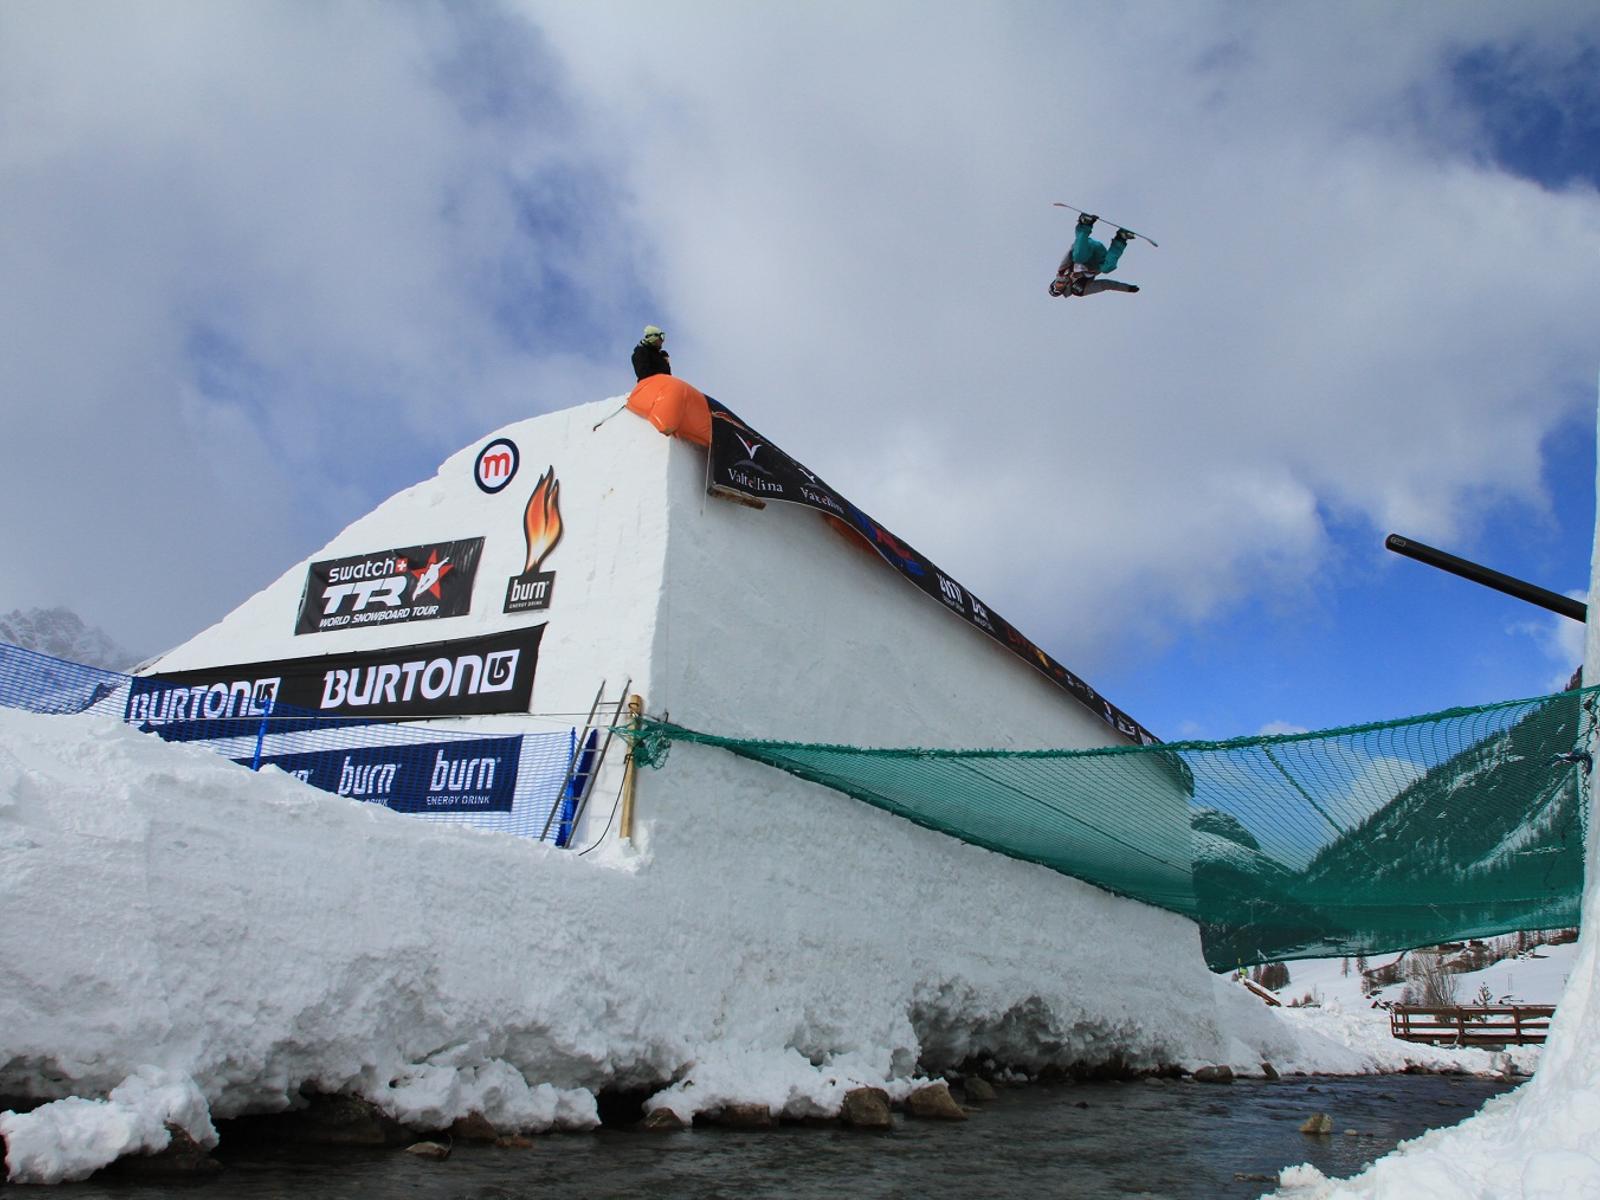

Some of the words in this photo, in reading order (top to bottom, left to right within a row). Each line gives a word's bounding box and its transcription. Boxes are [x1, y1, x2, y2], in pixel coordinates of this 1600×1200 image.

[728, 468, 783, 493] Valtellina
[322, 576, 407, 615] TTR
[511, 579, 546, 602] burn
[320, 616, 350, 628] WORLD
[351, 608, 409, 623] SNOWBOARD
[412, 605, 439, 617] TOUR
[320, 655, 483, 709] BURTON
[129, 680, 253, 726] BURTON
[337, 756, 396, 796] burn
[430, 749, 495, 791] burn
[426, 795, 460, 805] ENERGY
[461, 795, 490, 805] DRINK
